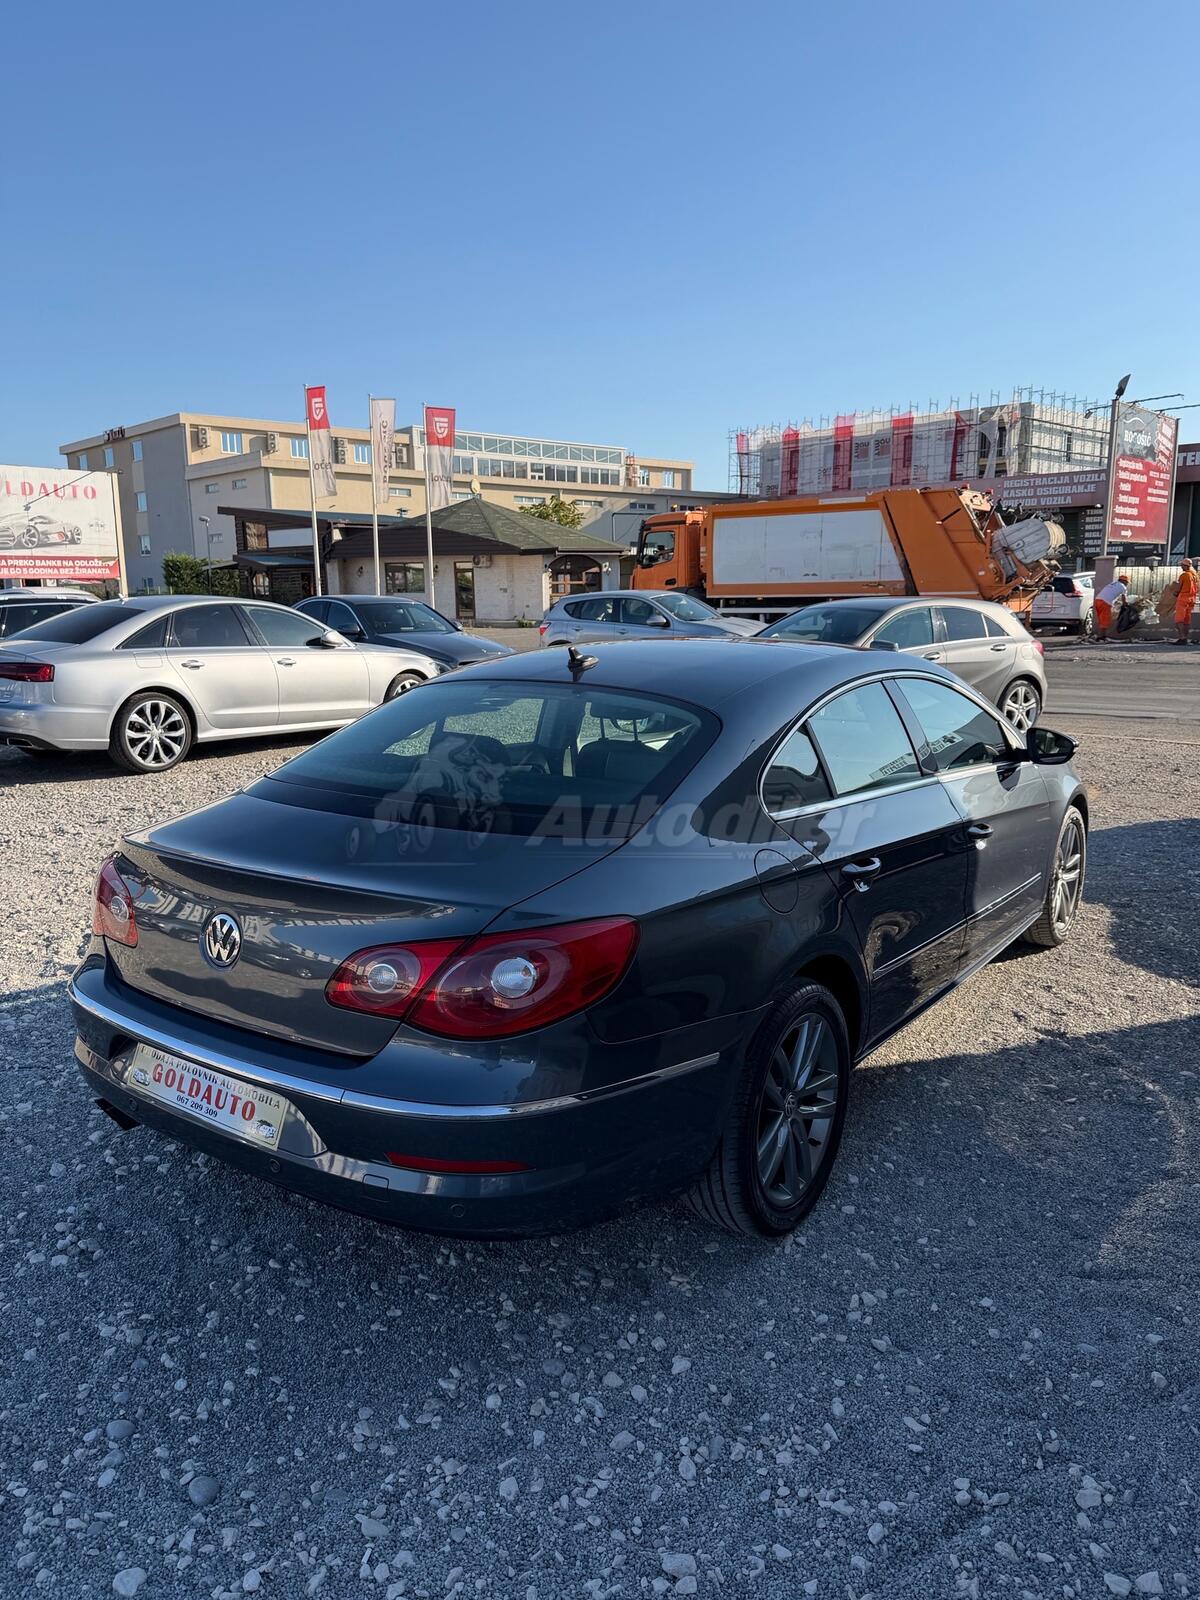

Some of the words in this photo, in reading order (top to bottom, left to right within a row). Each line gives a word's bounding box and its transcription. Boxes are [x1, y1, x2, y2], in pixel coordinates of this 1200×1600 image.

[1003, 476, 1070, 489] REGISTRACIJA
[1073, 472, 1106, 483] VOZILA
[0, 480, 97, 500] LDAUTO
[1003, 489, 1034, 498] KASKO
[1036, 484, 1097, 496] OSIGURANJE
[1040, 496, 1072, 506] VOZILA
[7, 559, 35, 567] PREKO
[35, 559, 63, 567] BANKE
[63, 559, 74, 567] NA
[74, 558, 111, 567] ODLOŽE
[10, 567, 22, 575] DO
[28, 567, 59, 575] GODINA
[59, 567, 74, 575] BEZ
[152, 1063, 256, 1121] GOLDAUTO
[220, 1078, 281, 1110] AUTOMOBILA
[176, 1094, 190, 1105] 067
[190, 1100, 204, 1112] 209
[204, 1107, 218, 1118] 309
